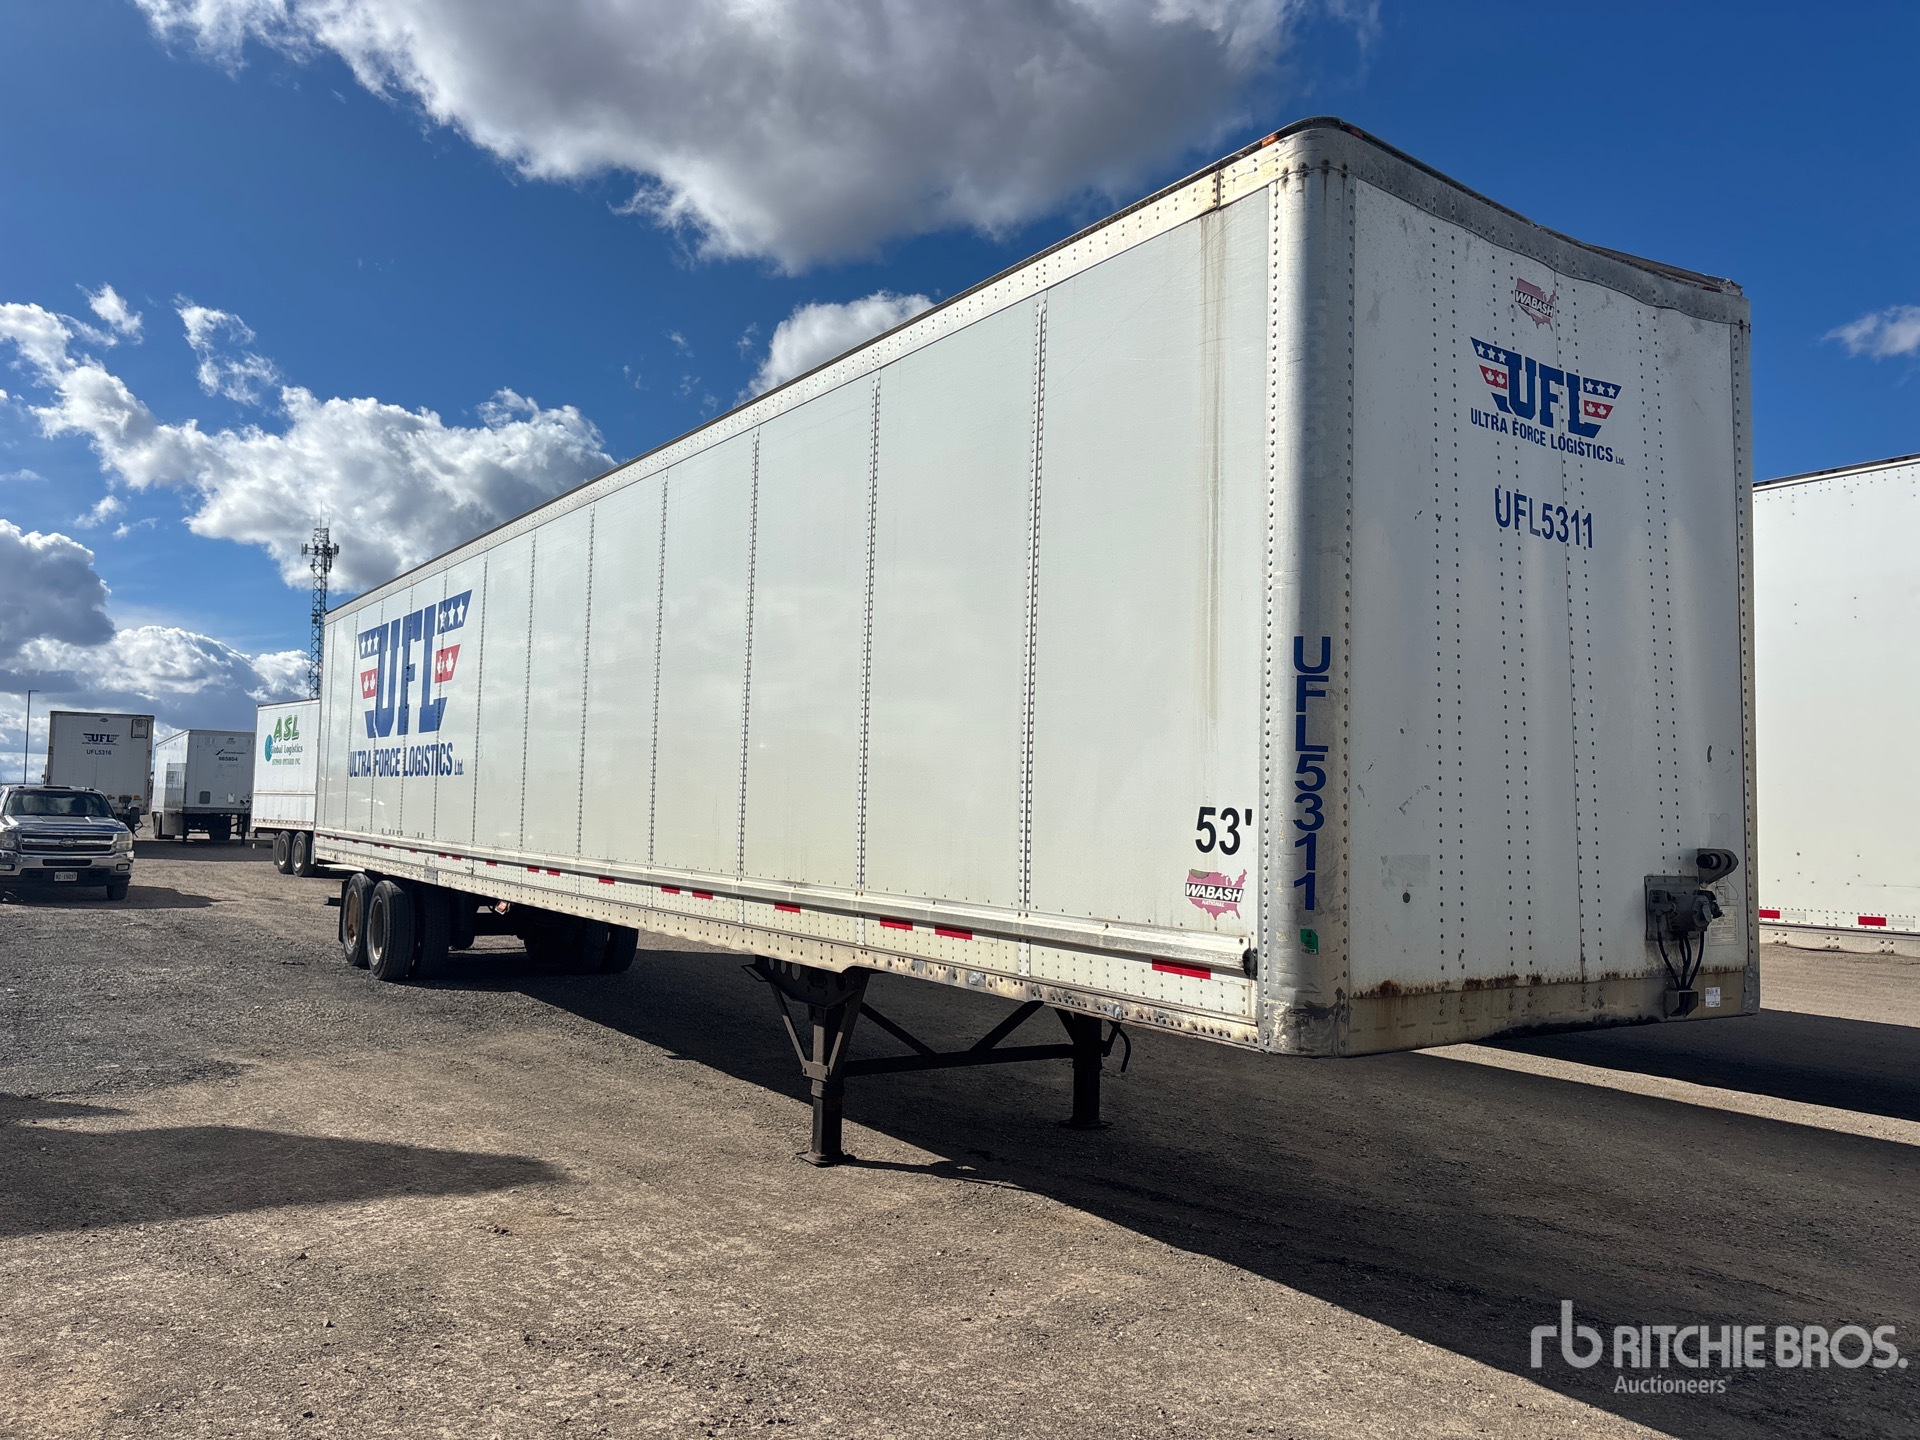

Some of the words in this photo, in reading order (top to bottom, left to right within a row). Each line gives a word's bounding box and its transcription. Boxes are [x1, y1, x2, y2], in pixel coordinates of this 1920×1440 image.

[1515, 290, 1554, 317] WABASH
[1470, 337, 1601, 438] UFL
[1470, 407, 1508, 434] ULTRA
[1512, 421, 1546, 446] FORCE
[1550, 435, 1613, 463] LOGISTICS
[1494, 487, 1593, 548] UFL5311
[358, 604, 447, 738] UFL
[83, 733, 114, 743] UFL
[273, 714, 299, 743] ASL
[283, 743, 303, 755] Logistics
[349, 750, 371, 777] ULTRA
[374, 749, 400, 776] FORCE
[402, 742, 453, 776] LOGISTICS
[1293, 636, 1331, 911] UFL5311
[1195, 806, 1253, 855] 53'
[1186, 883, 1243, 902] WABASH
